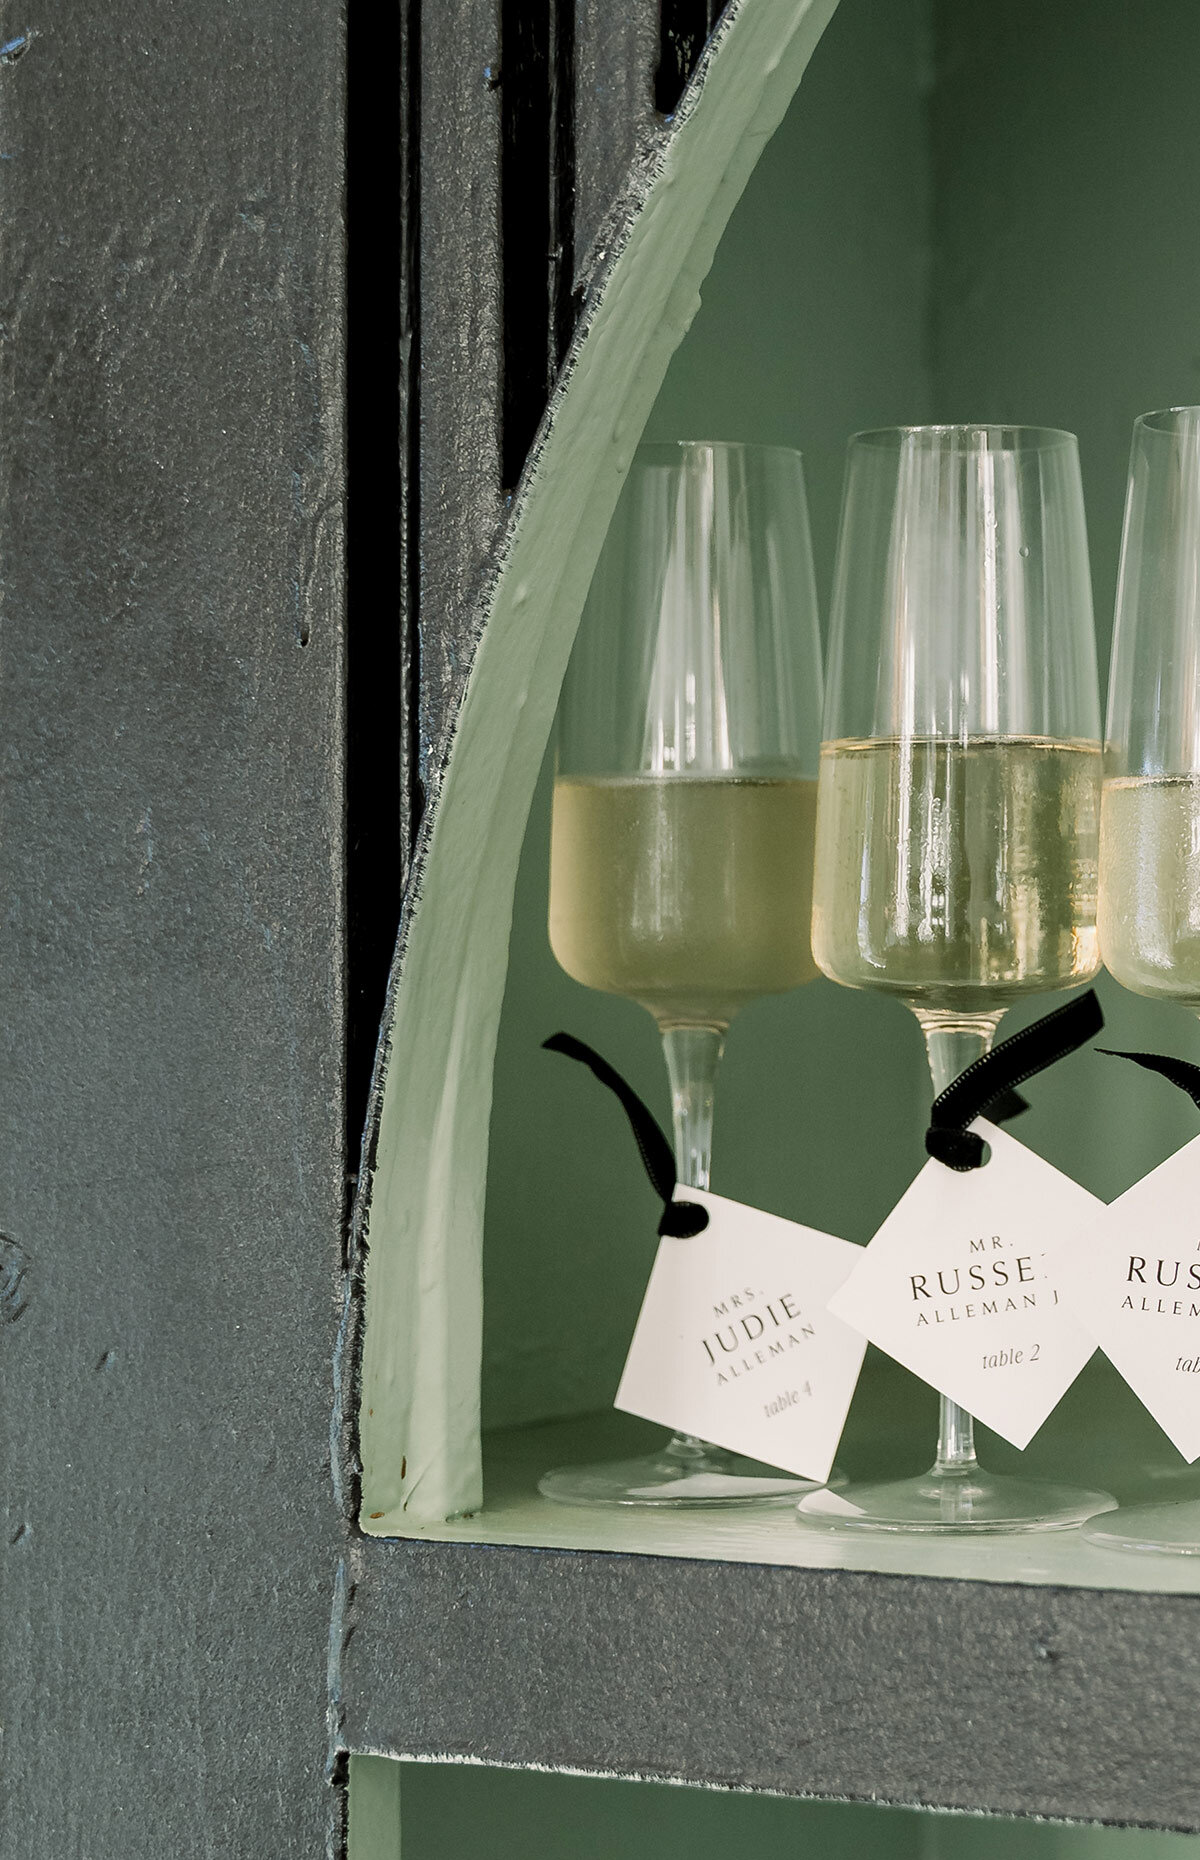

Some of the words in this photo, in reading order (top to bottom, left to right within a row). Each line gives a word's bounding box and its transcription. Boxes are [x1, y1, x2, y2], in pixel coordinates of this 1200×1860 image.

[970, 1236, 1014, 1253] MR.
[910, 1252, 1048, 1301] RUSSE
[713, 1287, 764, 1318] MRS.
[917, 1293, 1037, 1326] ALLEMAN
[702, 1293, 802, 1368] JUDIE
[717, 1323, 816, 1386] ALLEMAN
[982, 1347, 1024, 1370] table
[1029, 1343, 1041, 1362] 2
[764, 1390, 800, 1418] table
